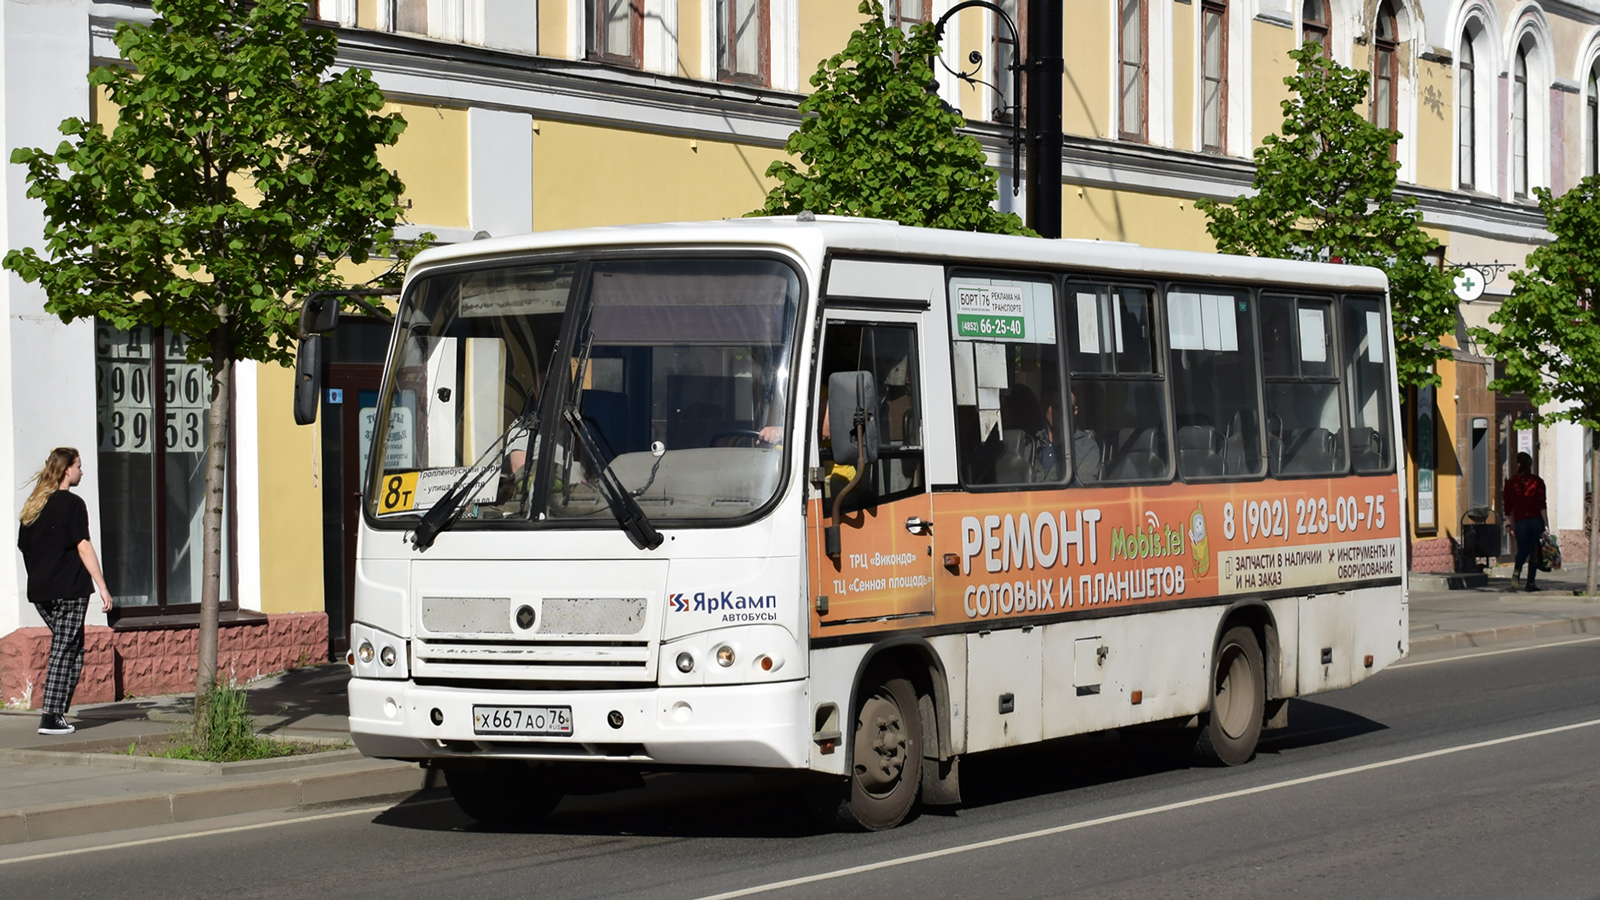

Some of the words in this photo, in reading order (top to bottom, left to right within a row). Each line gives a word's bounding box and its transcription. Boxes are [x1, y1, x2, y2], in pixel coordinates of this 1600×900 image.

[991, 292, 1013, 301] РЕКЛАМА
[992, 304, 1022, 312] ТРАНСПОРТЕ
[961, 321, 979, 333] (4852)
[980, 318, 1021, 335] 66-25-40
[1223, 502, 1235, 540] 8
[1242, 498, 1289, 543] (902)
[1296, 494, 1385, 534] 223-00-75
[961, 508, 1101, 575] РЕМОНТ
[1110, 522, 1186, 561] Mobis.tel
[849, 553, 868, 570] ТРЦ
[870, 552, 917, 567] «Виконда»
[1235, 553, 1275, 571] ЗАПЧАСТИ
[1277, 553, 1283, 568] В
[1285, 550, 1322, 566] НАЛИЧИИ
[1337, 544, 1388, 562] ИНСТРУМЕНТЫ
[1389, 543, 1396, 557] И
[1337, 560, 1393, 579] ОБОРУДОВАНИЕ
[833, 579, 846, 595] ТЦ
[848, 577, 886, 592] «Сенная
[888, 575, 932, 589] площадь»
[1236, 574, 1242, 589] И
[1245, 573, 1256, 588] НА
[1258, 571, 1282, 587] ЗАКАЗ
[964, 577, 1055, 618] СОТОВЫХ
[1059, 576, 1073, 607] И
[1079, 565, 1186, 606] ПЛАНШЕТОВ
[693, 590, 776, 614] ЯрКамп
[722, 612, 777, 622] АВТОБУСЫ
